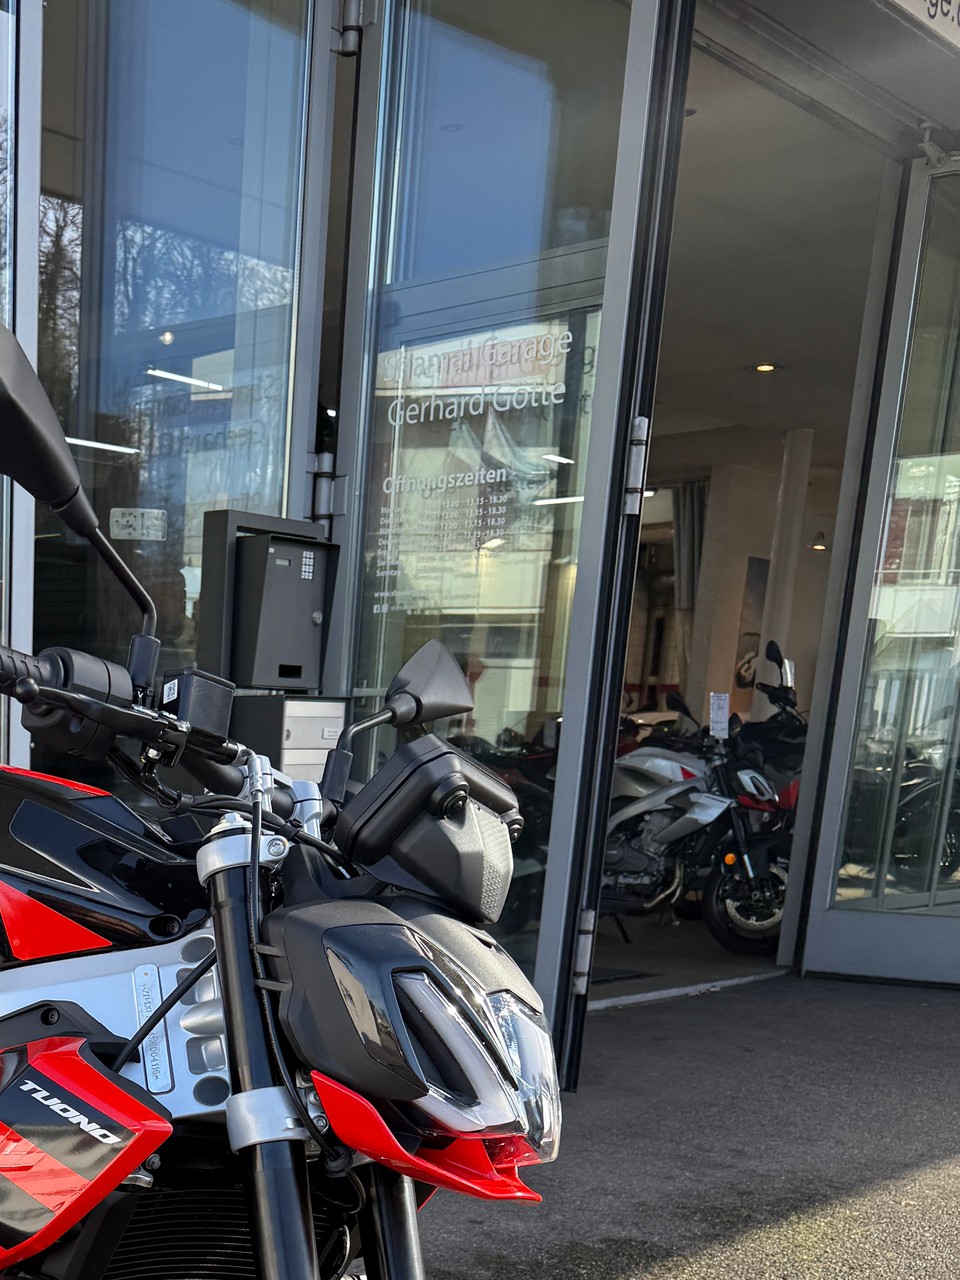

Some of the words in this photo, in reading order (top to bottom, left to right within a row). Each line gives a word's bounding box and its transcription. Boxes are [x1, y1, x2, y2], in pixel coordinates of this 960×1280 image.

[481, 329, 573, 366] Garage
[387, 385, 484, 426] Gerhard
[19, 1079, 122, 1145] TUONO
